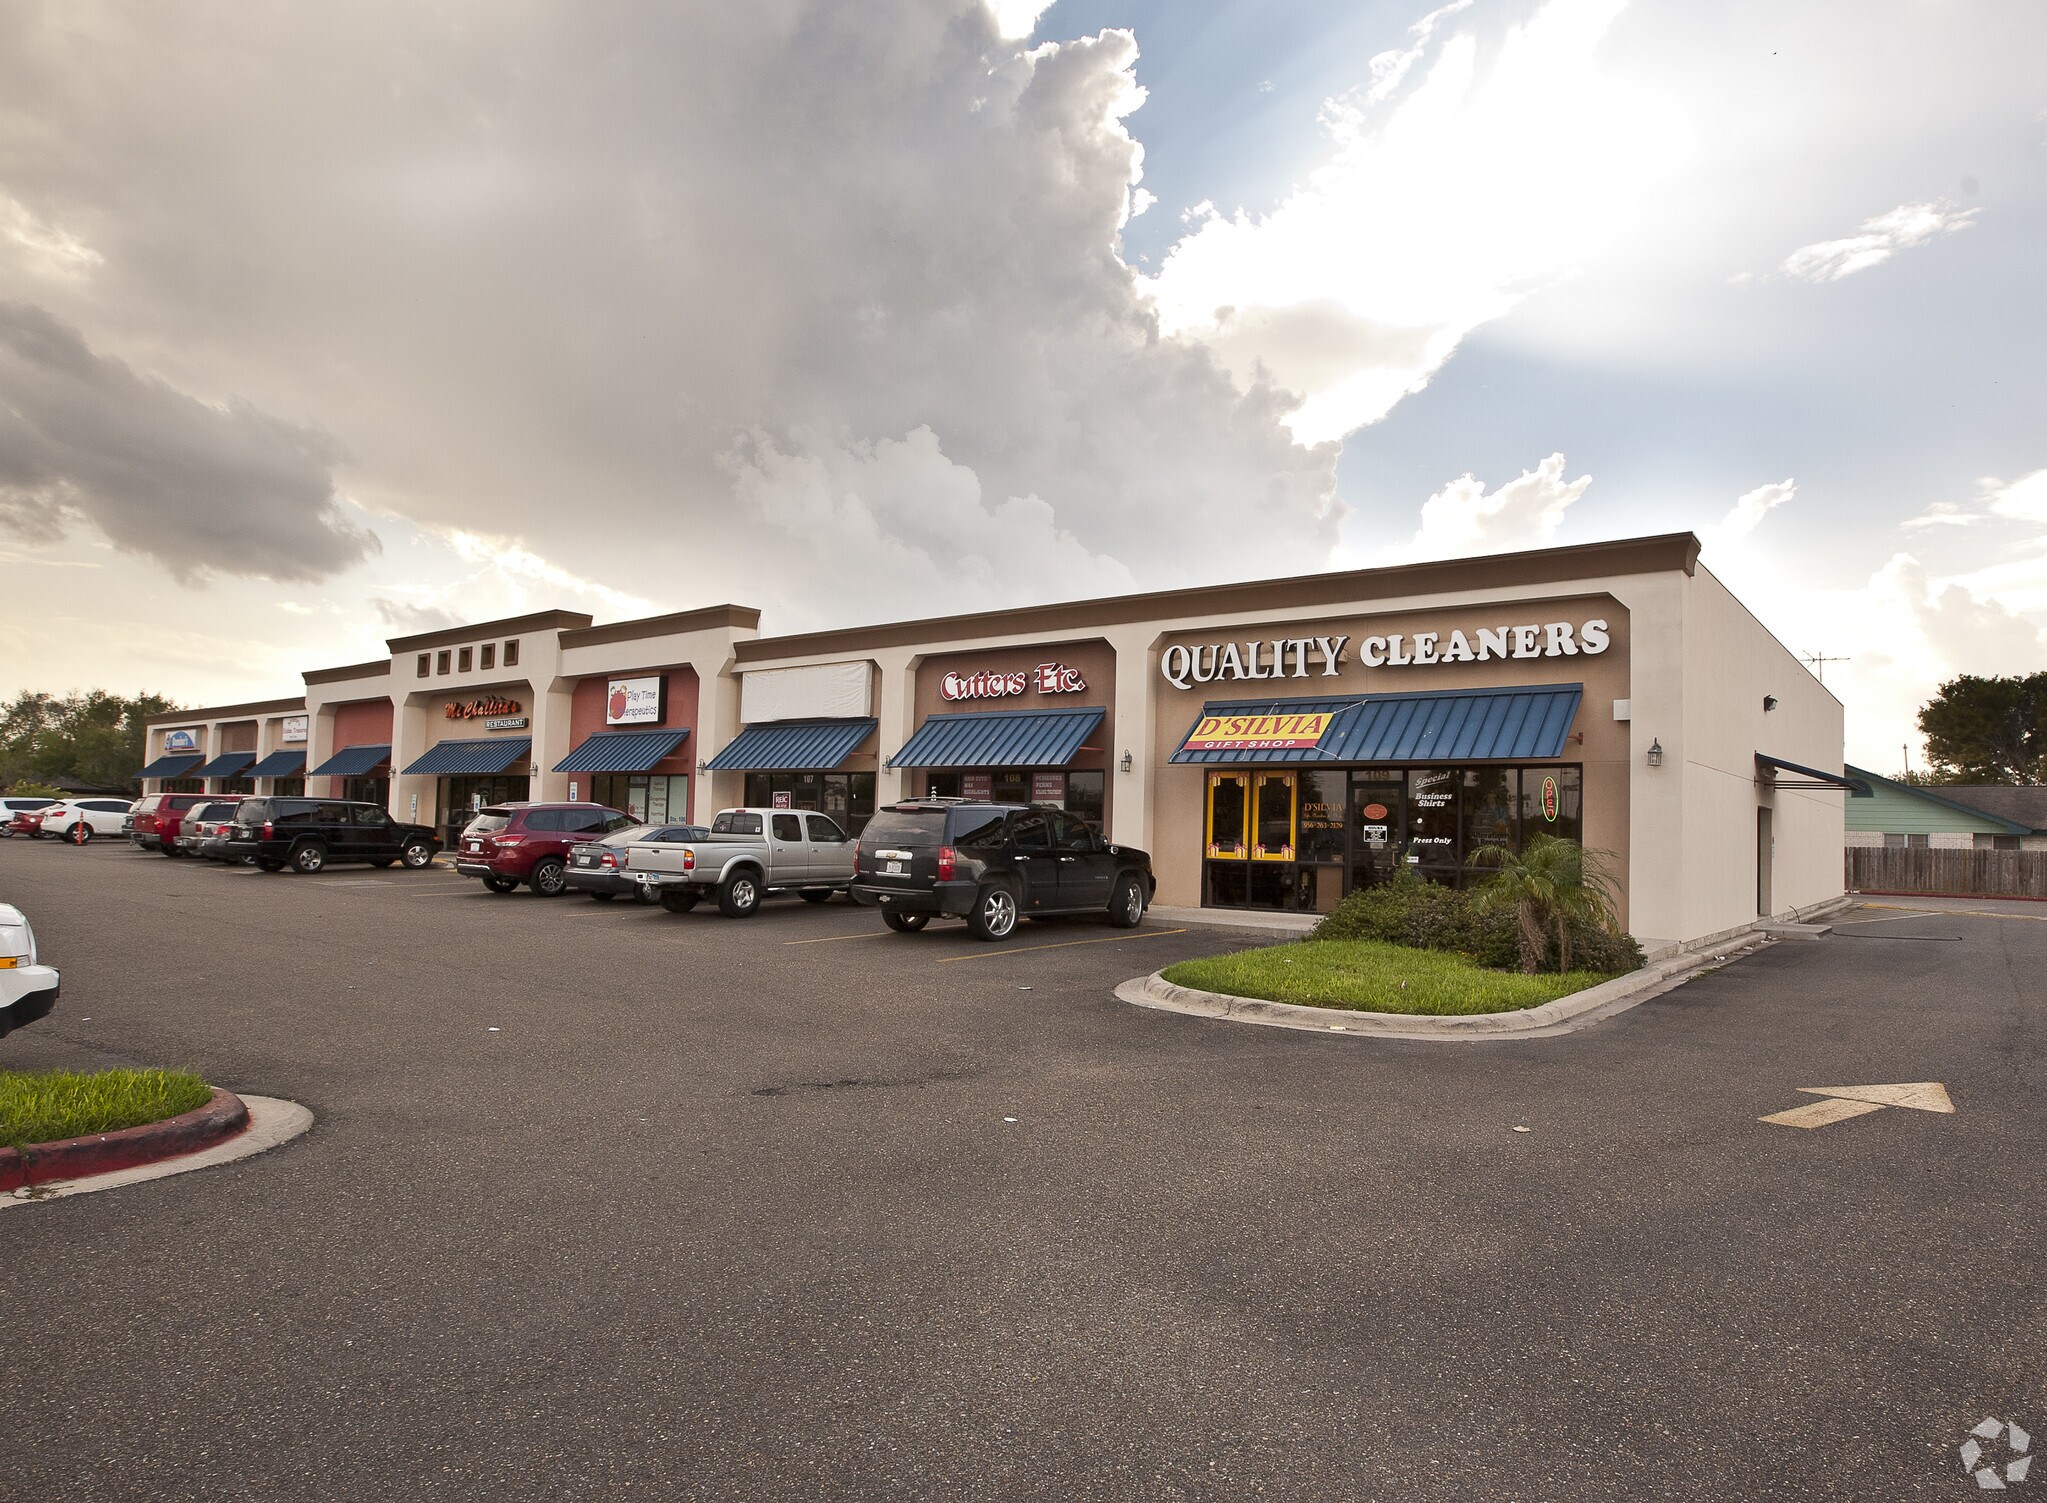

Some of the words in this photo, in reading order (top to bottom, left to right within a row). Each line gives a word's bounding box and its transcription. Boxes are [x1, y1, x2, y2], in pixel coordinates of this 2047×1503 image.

[1160, 634, 1348, 690] QUALITY
[1360, 619, 1610, 668] CLEANERS
[940, 671, 1028, 700] Cutters
[1033, 662, 1087, 694] Etc.
[627, 690, 640, 702] Play
[642, 690, 656, 700] Time
[444, 702, 460, 719] Mi
[620, 705, 657, 719] erapeutics
[486, 719, 523, 728] RESTAURANT
[1195, 715, 1323, 737] D'SILVIA
[1204, 740, 1244, 749] GIFT
[1247, 740, 1296, 748] SHOP
[803, 774, 814, 783] 107
[1004, 773, 1021, 782] 108
[1415, 770, 1451, 786] Special
[1415, 792, 1453, 800] Business
[1304, 802, 1343, 811] D'SILVIA
[1418, 799, 1446, 807] Shirts
[1412, 836, 1433, 844] Press
[1433, 836, 1453, 845] Only
